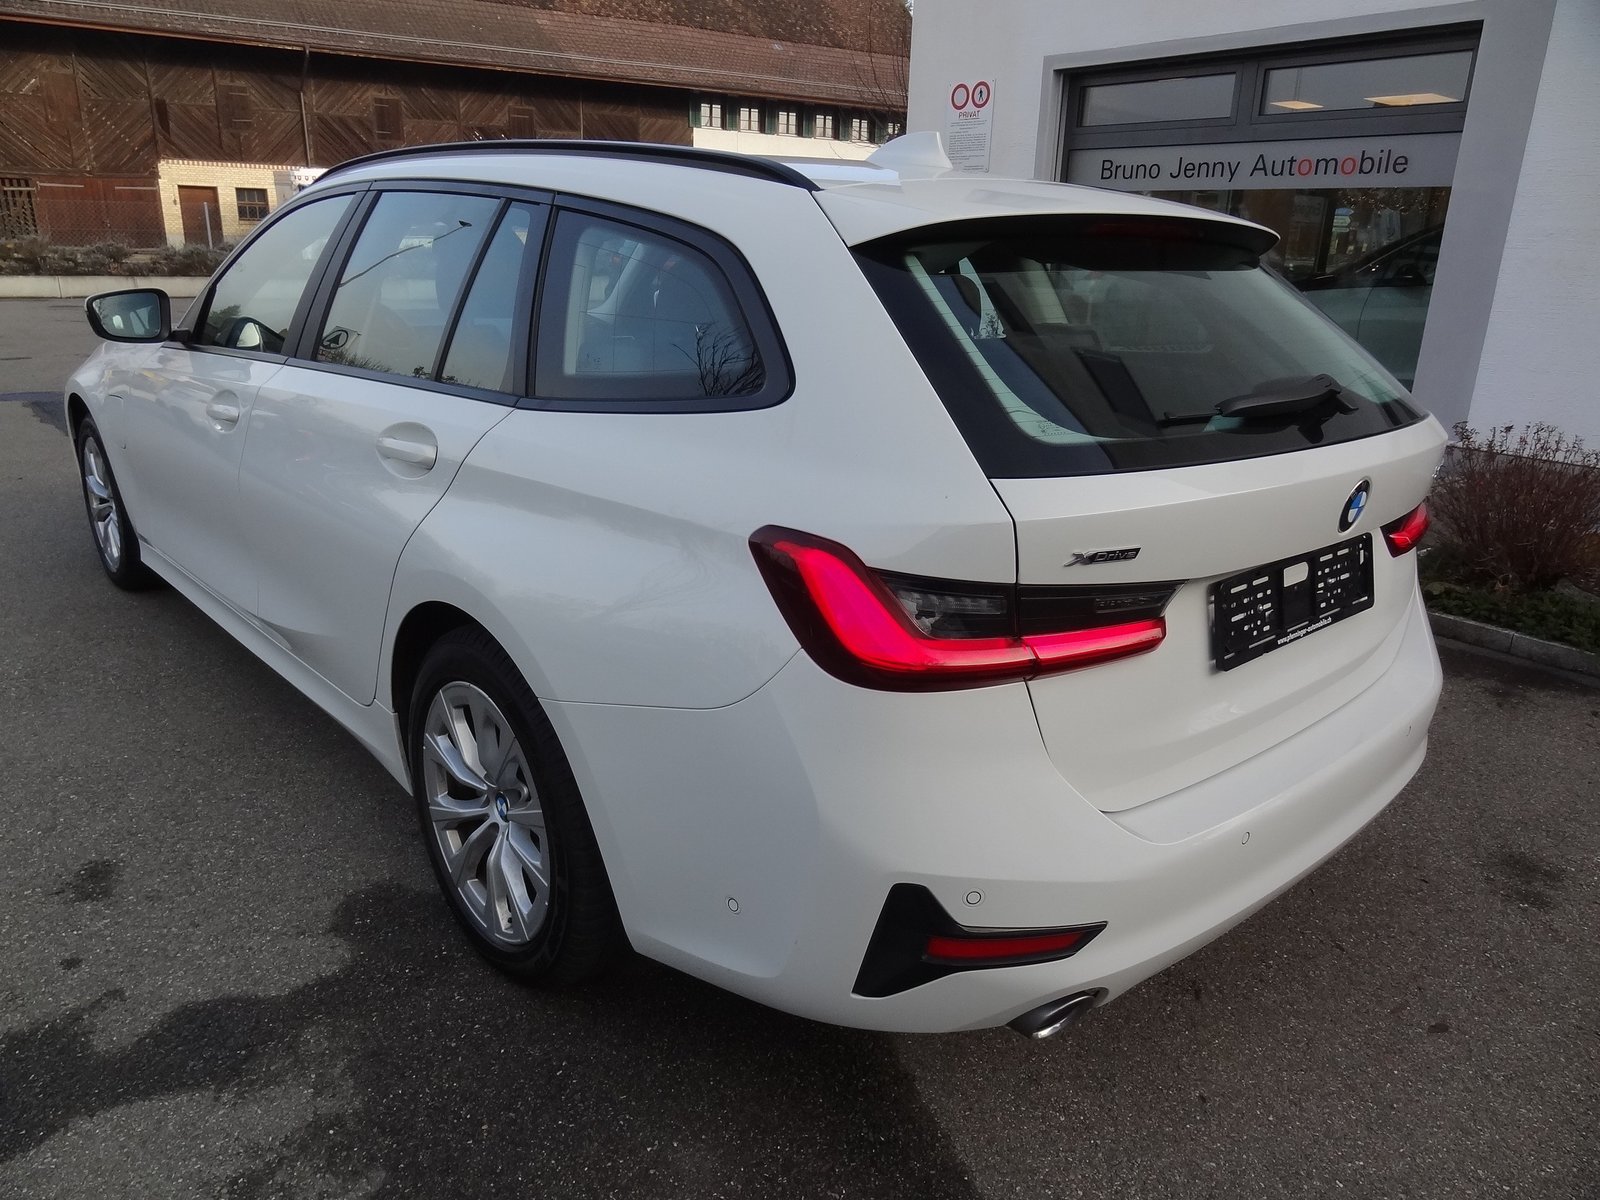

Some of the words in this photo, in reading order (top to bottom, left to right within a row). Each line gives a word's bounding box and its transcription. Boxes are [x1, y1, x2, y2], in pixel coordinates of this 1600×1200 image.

[958, 110, 981, 119] PRIVAT
[1100, 160, 1161, 180] Bruno
[1169, 157, 1241, 182] Jenny
[1250, 150, 1409, 178] Automobile
